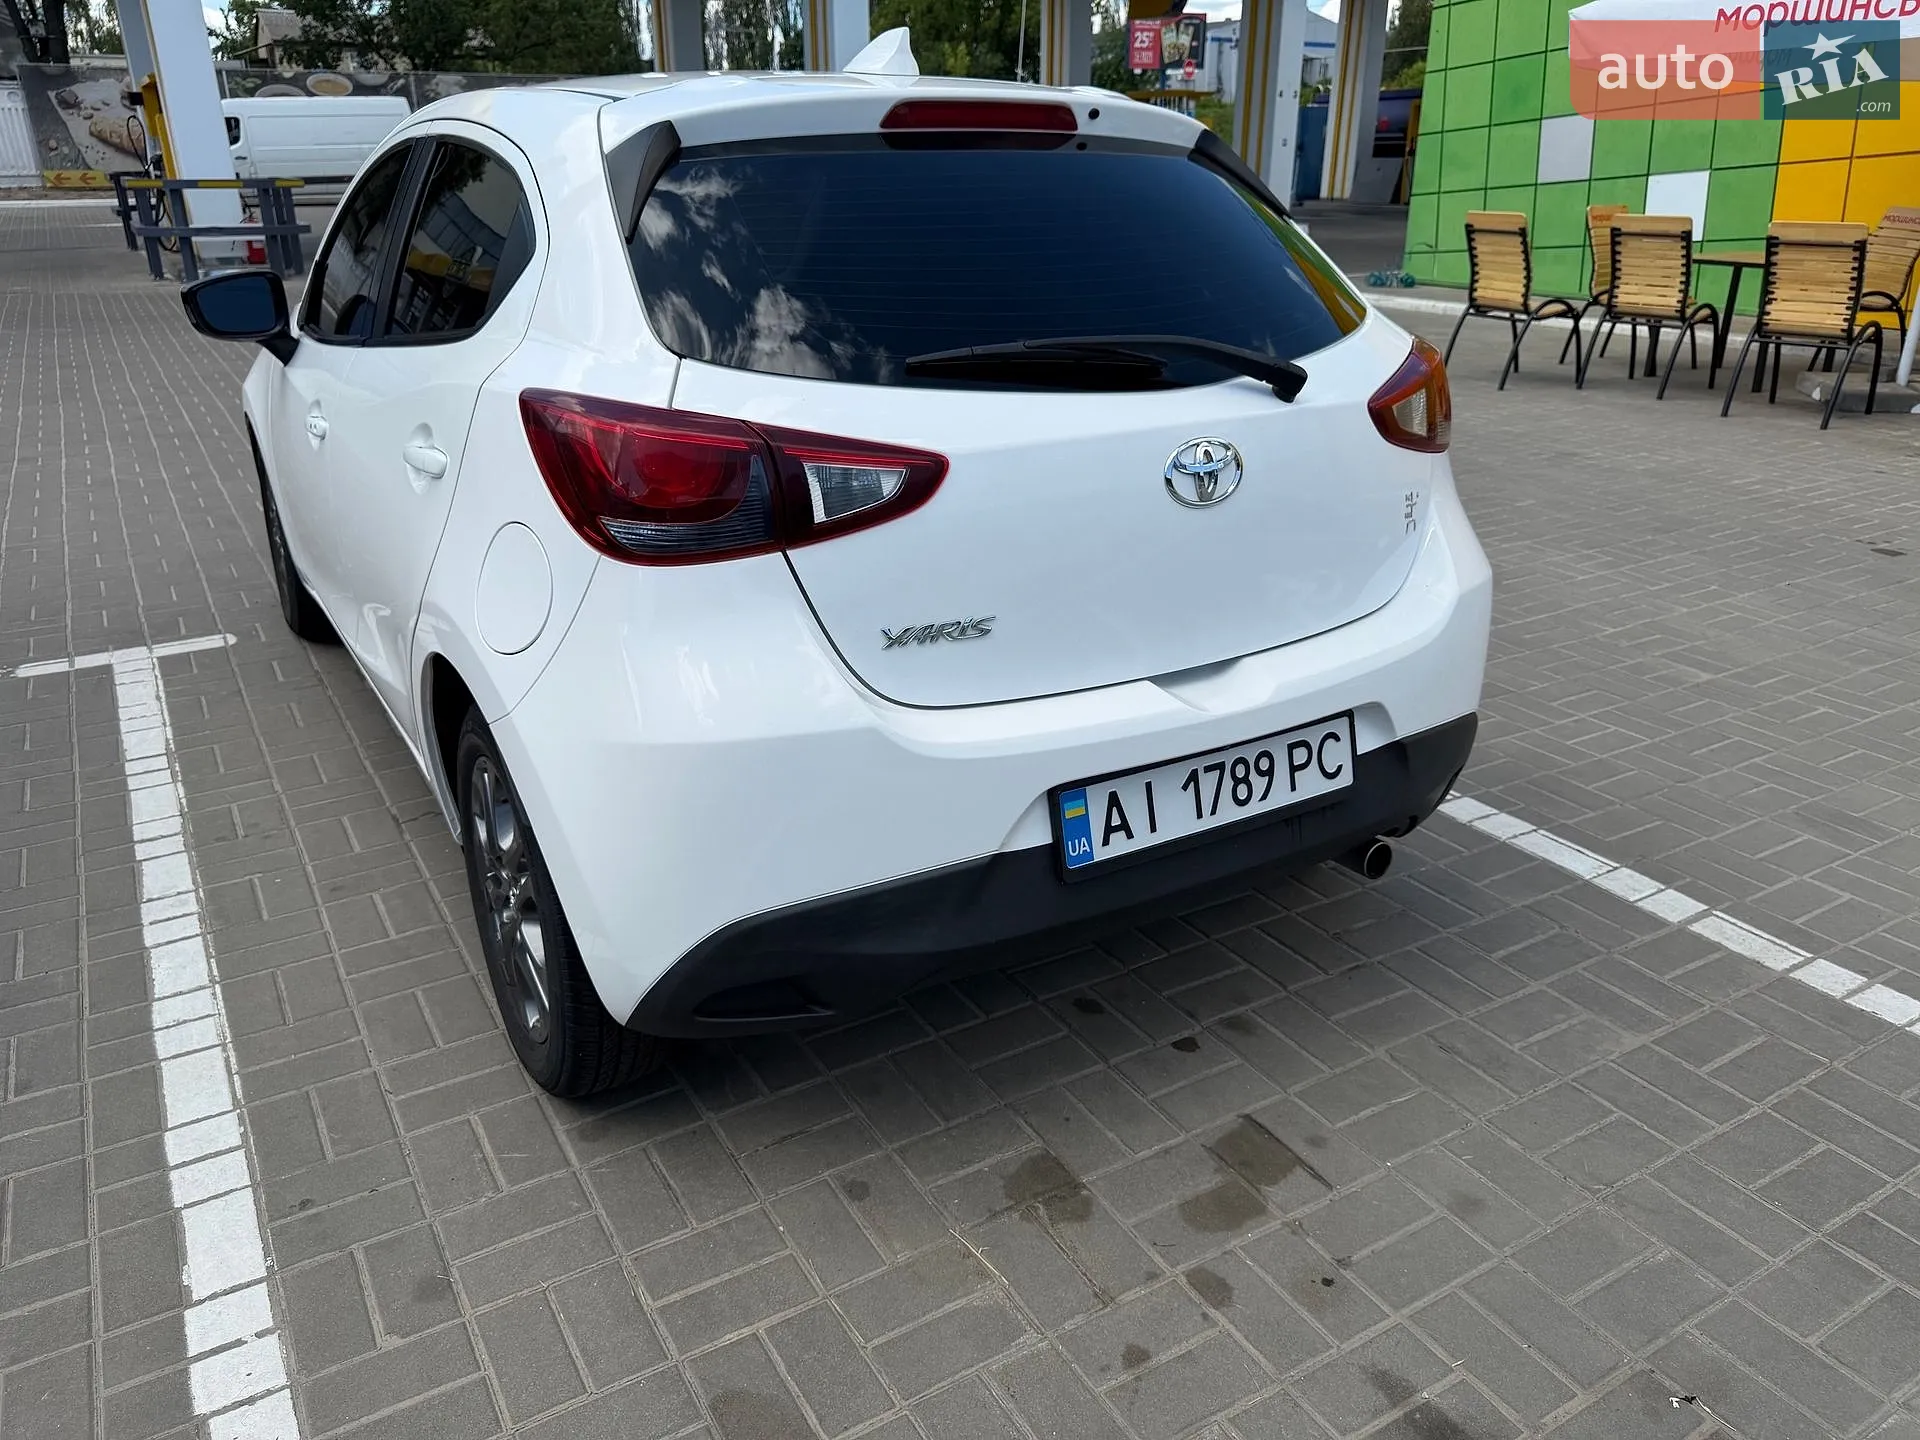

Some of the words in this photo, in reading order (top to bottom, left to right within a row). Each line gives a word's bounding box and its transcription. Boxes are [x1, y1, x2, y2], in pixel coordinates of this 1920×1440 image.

[881, 616, 996, 650] YARIS
[1101, 779, 1157, 848] AI
[1181, 749, 1276, 821] 1789
[1287, 731, 1344, 793] PC
[1068, 837, 1091, 857] UA
